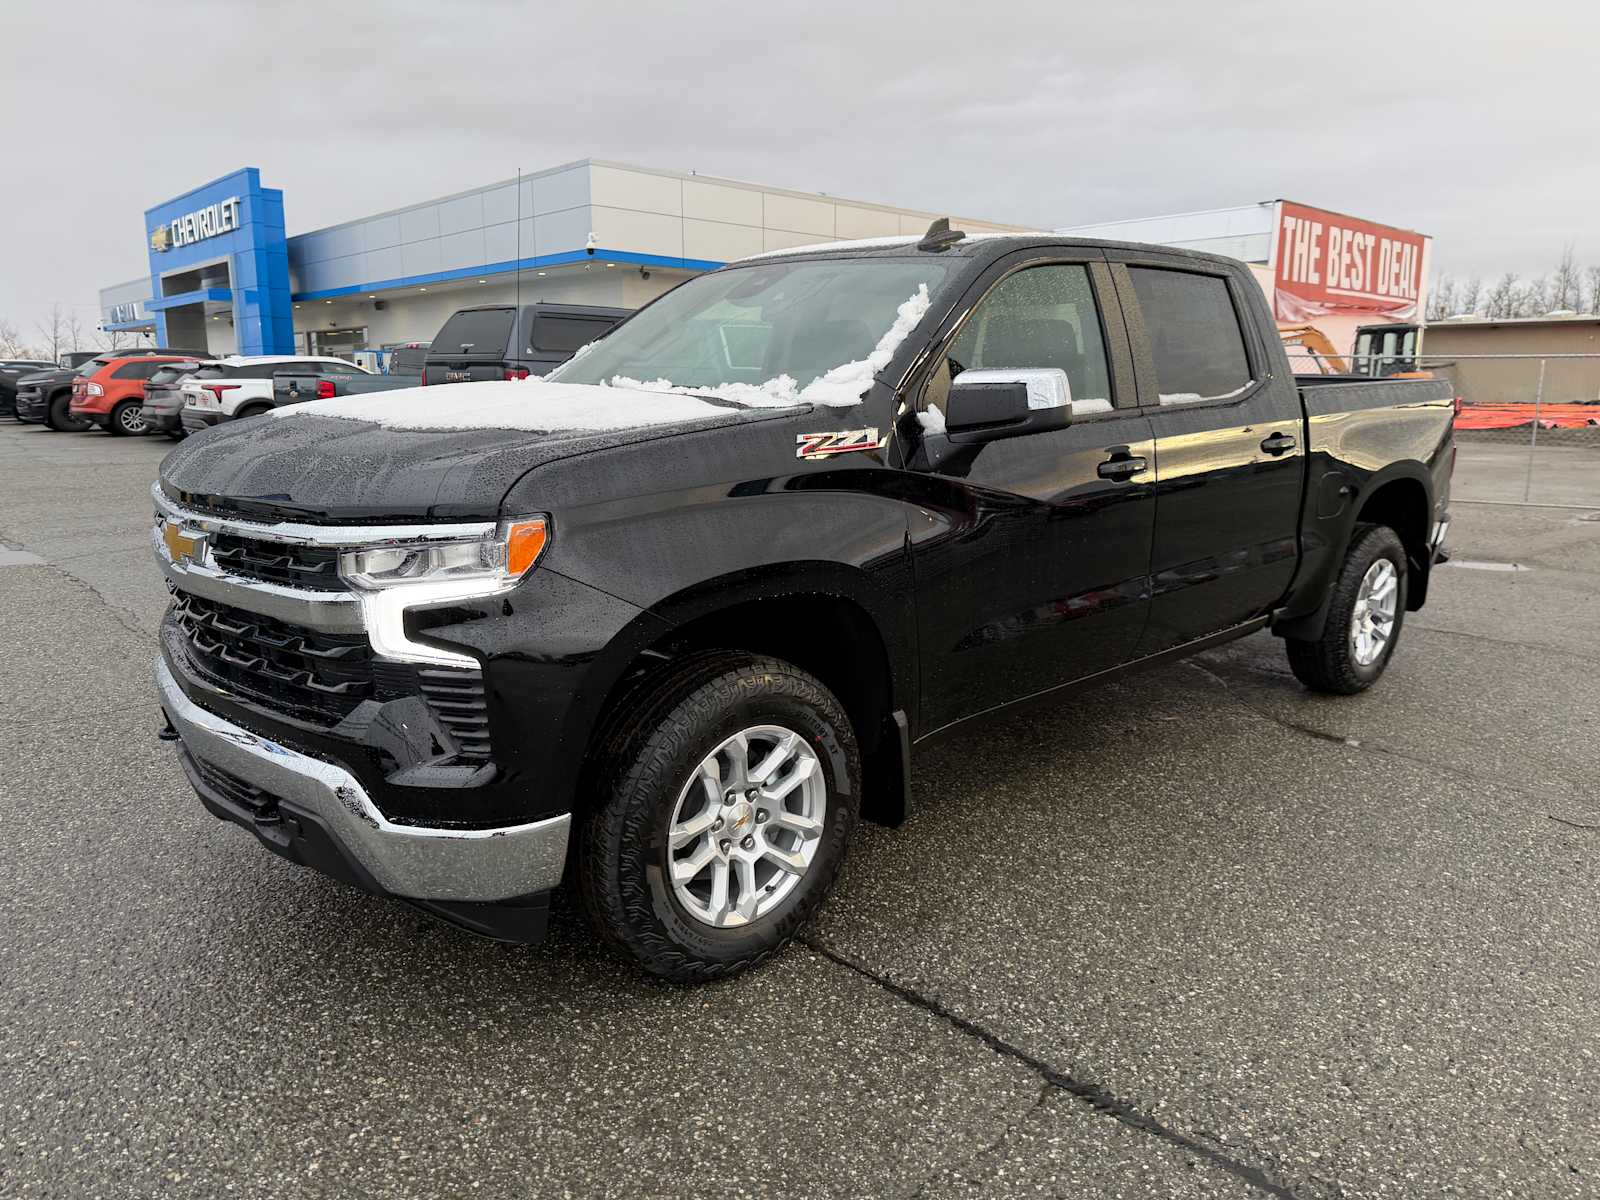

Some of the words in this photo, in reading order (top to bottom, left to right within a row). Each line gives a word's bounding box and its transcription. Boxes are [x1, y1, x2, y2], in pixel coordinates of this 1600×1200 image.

[171, 196, 240, 247] CHEVROLET
[1283, 216, 1322, 284] THE
[1326, 226, 1376, 292] BEST
[1377, 238, 1418, 299] DEAL
[796, 428, 879, 457] Z71
